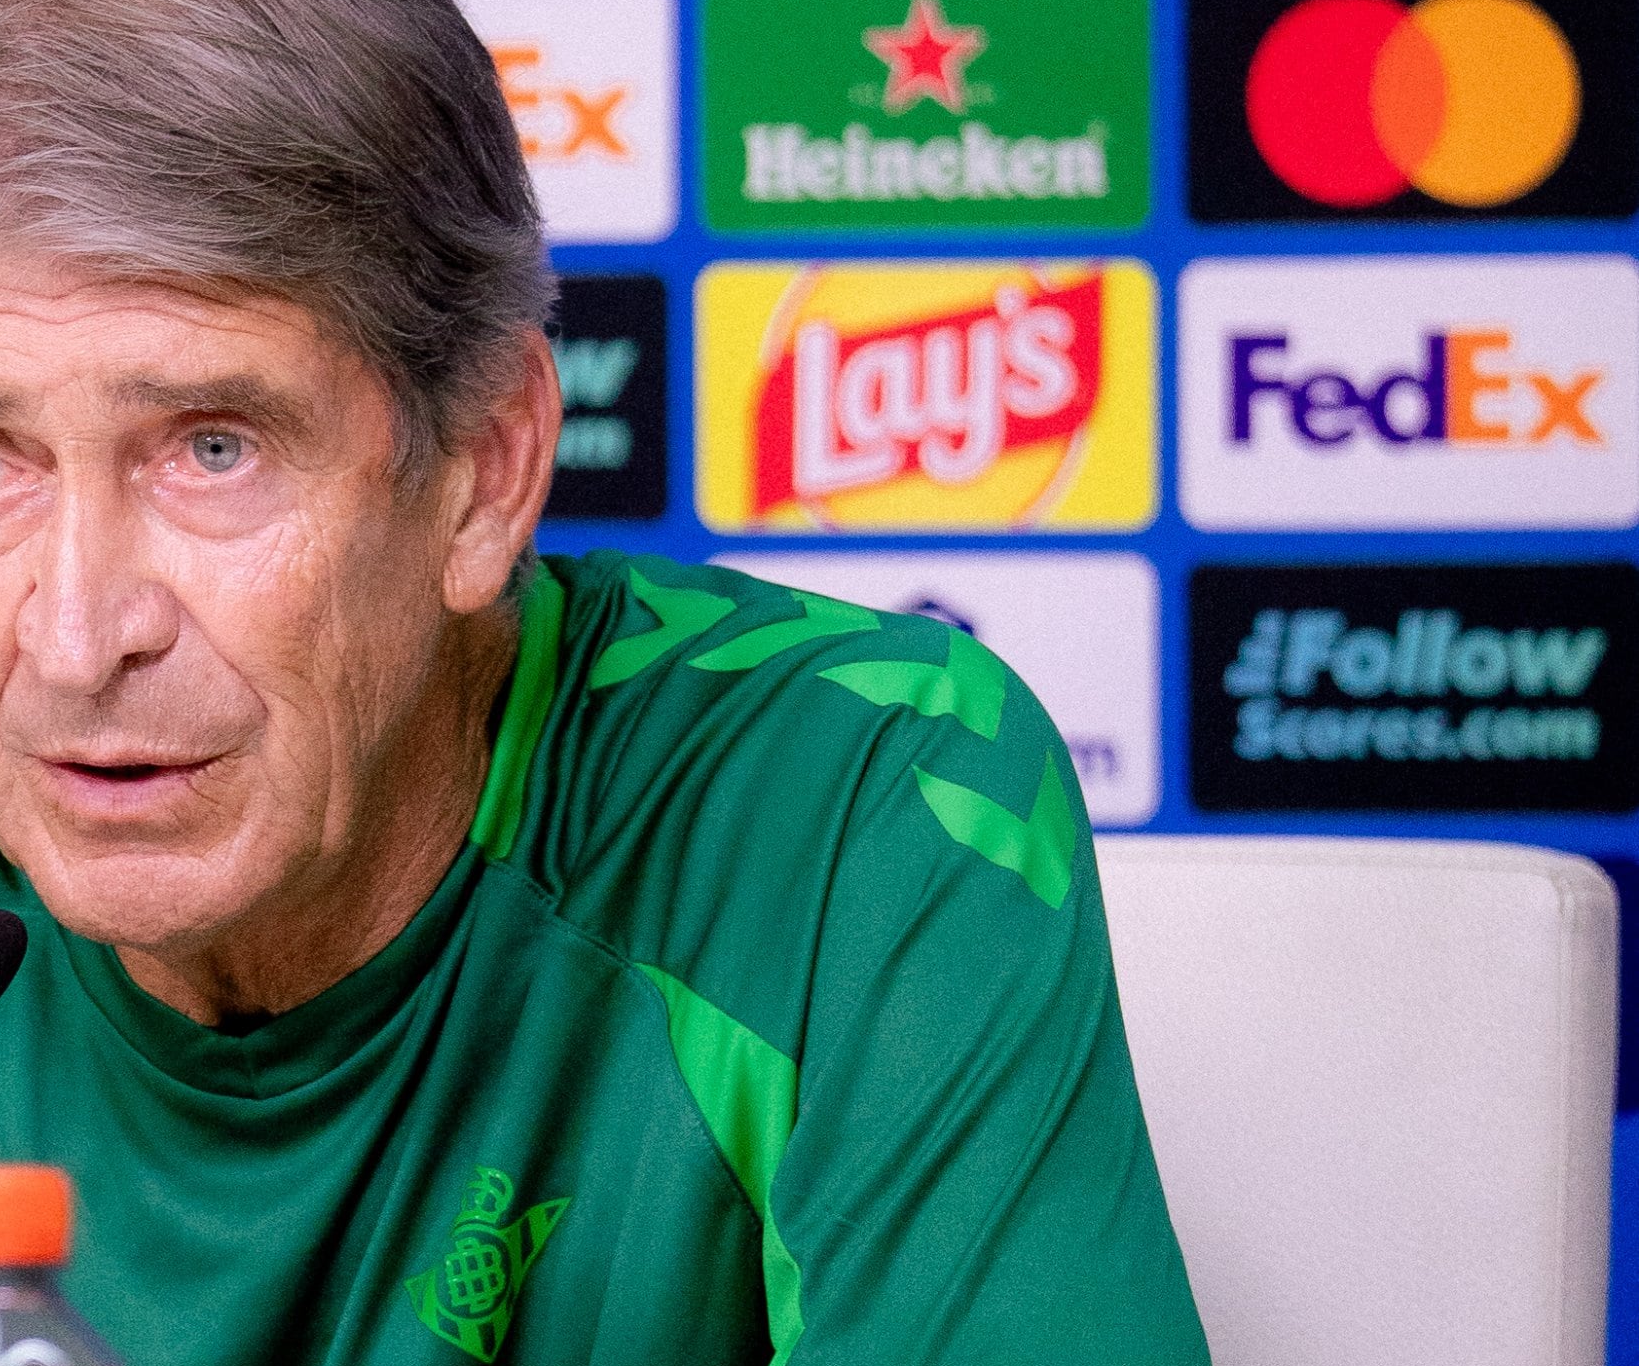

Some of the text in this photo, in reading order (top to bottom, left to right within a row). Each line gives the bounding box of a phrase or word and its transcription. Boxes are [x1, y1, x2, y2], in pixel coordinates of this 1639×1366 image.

[743, 122, 1109, 201] Heineken
[792, 283, 1076, 499] Lay's
[1228, 331, 1604, 445] FedEx
[1233, 700, 1602, 761] Scores.com
